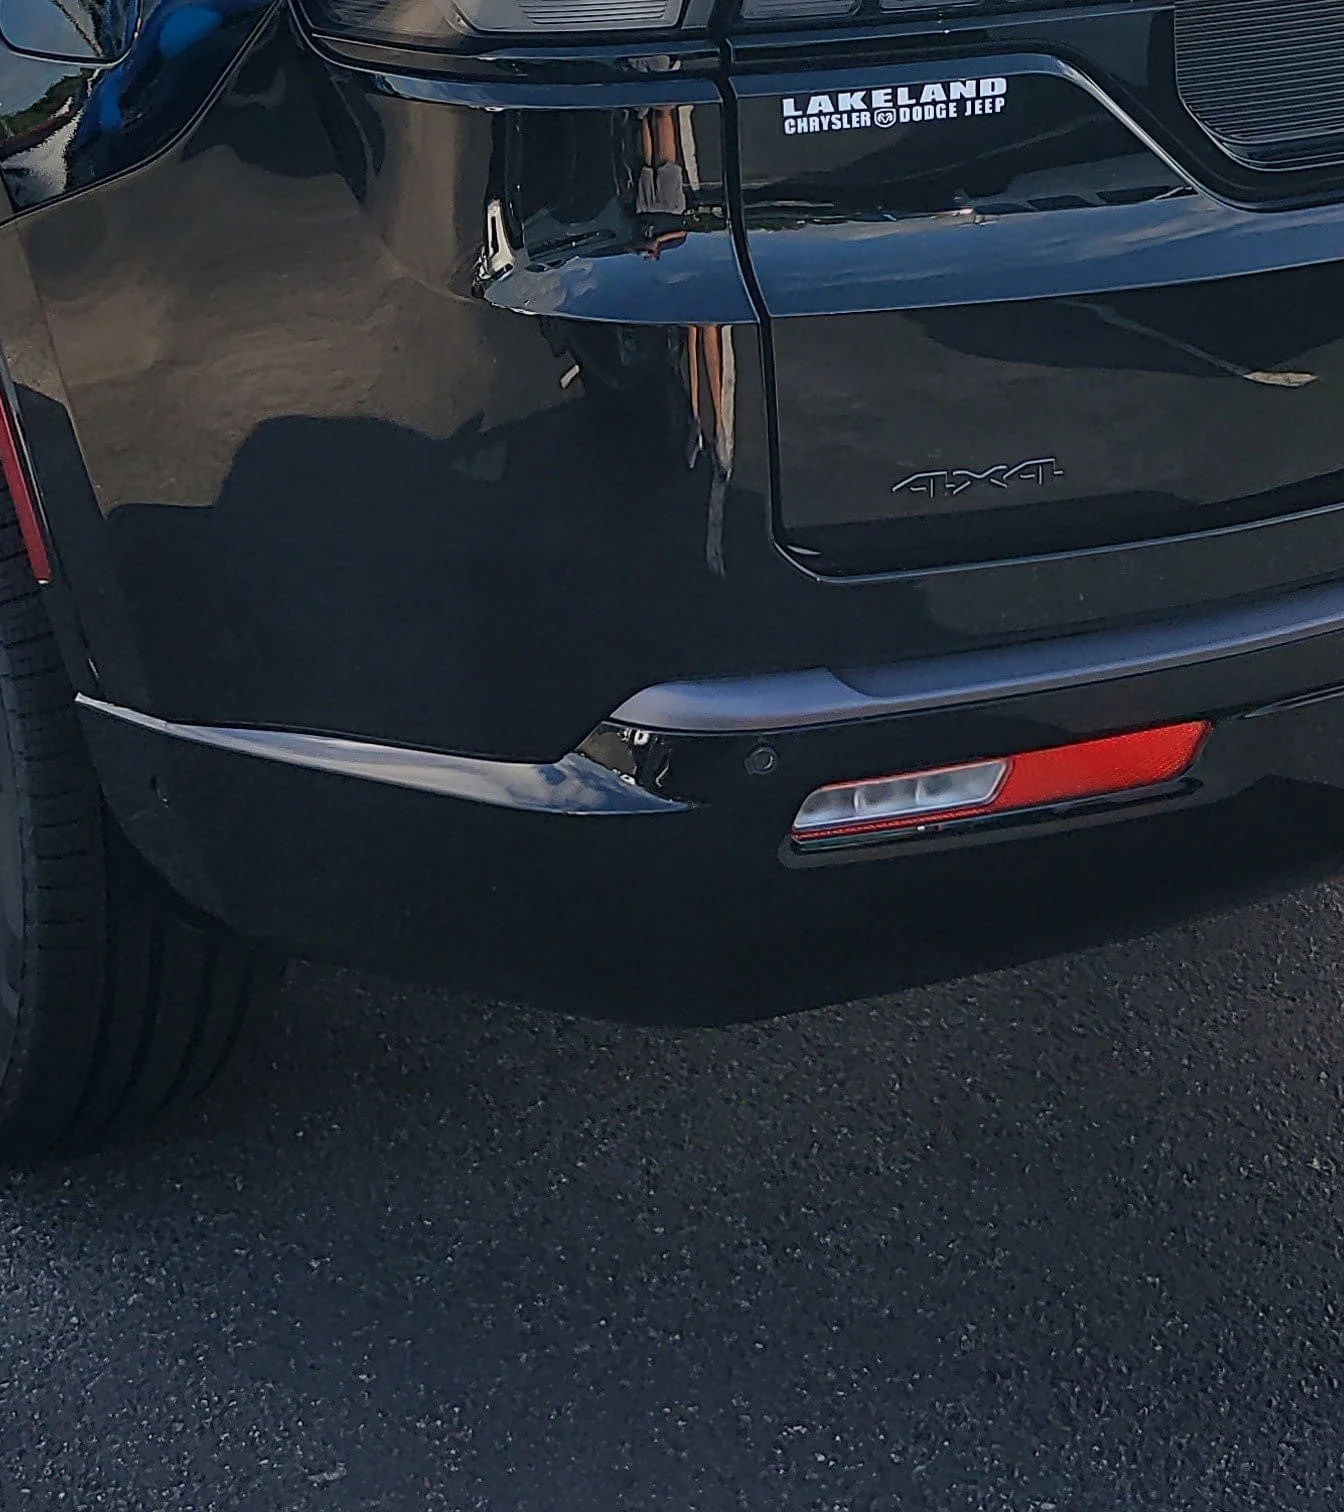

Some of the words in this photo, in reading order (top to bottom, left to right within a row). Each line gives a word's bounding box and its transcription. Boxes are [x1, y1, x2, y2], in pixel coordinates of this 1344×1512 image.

[782, 77, 1007, 117] LAKELAND
[784, 111, 871, 135] CHRYSLER
[899, 102, 957, 123] DODGE
[965, 97, 1005, 116] JEEP
